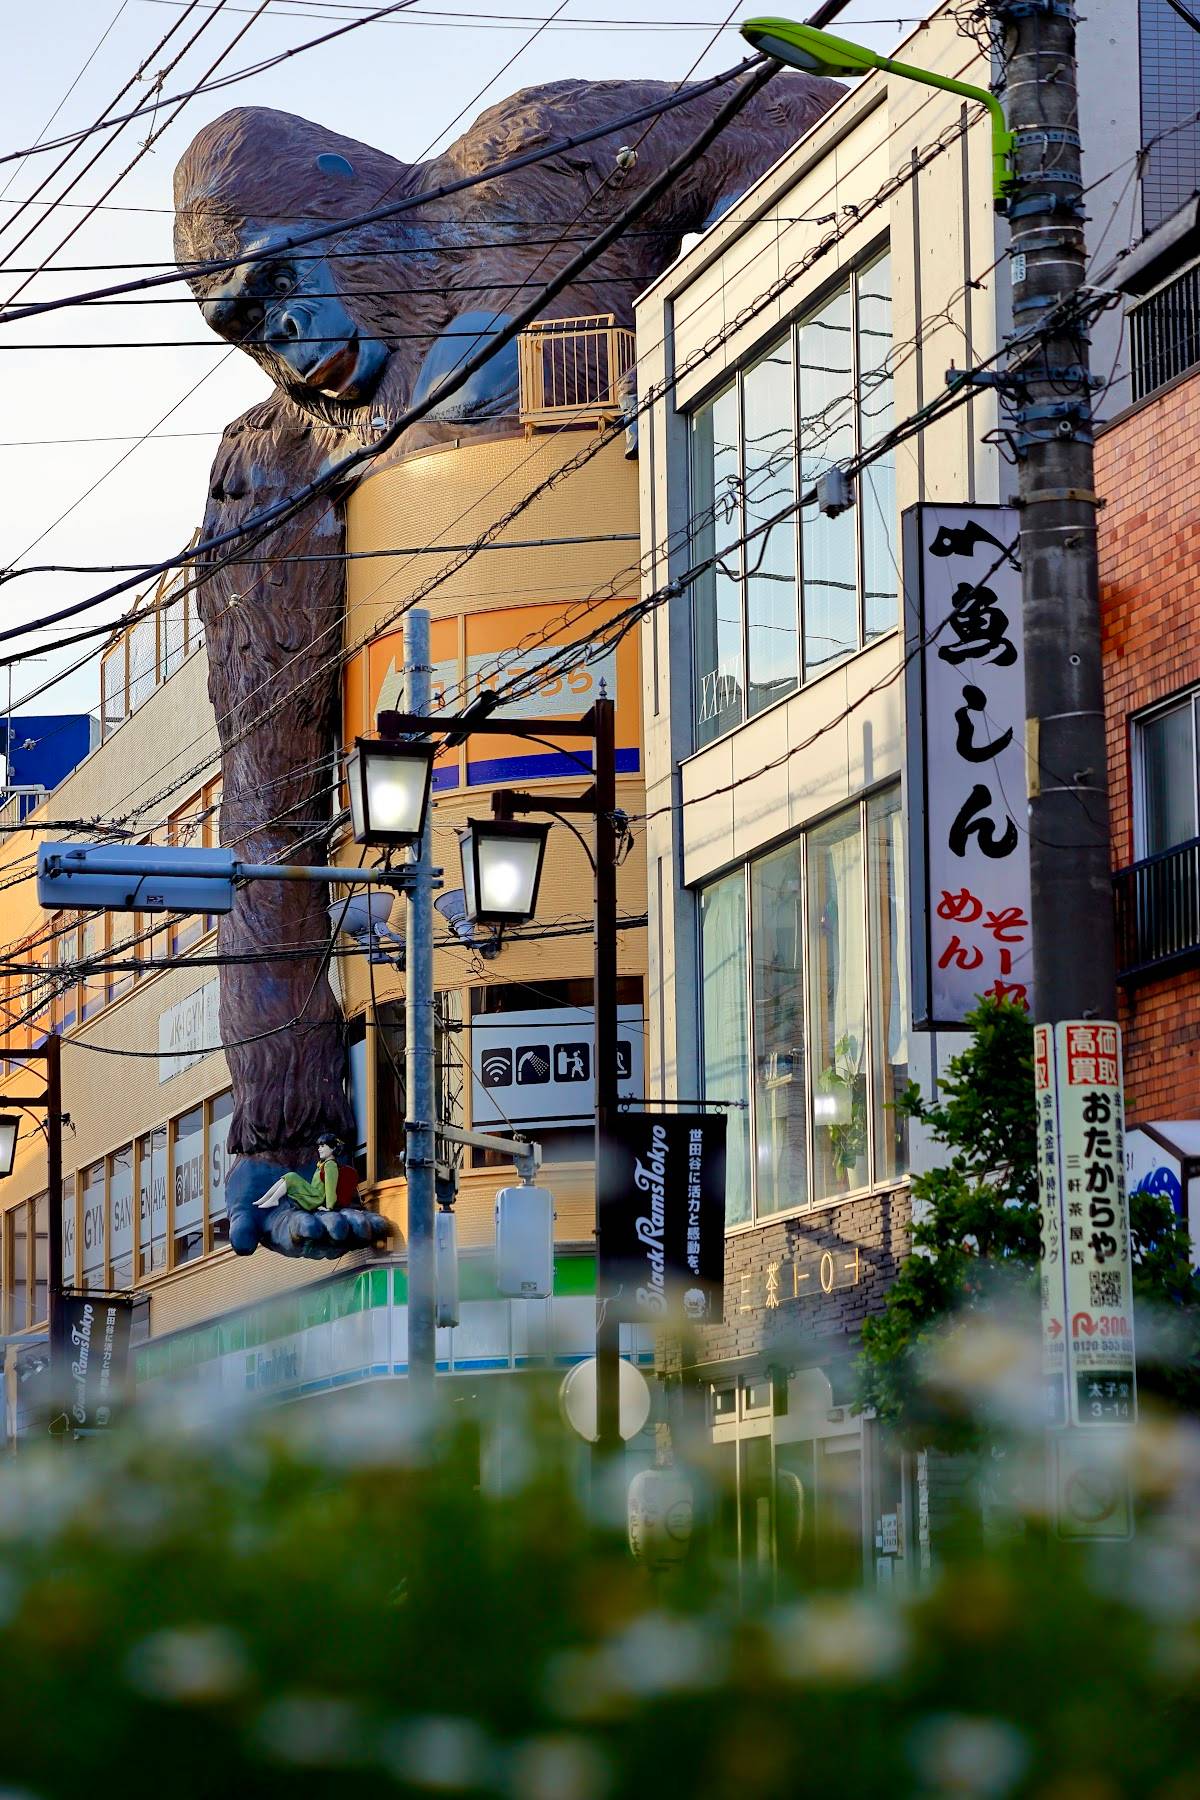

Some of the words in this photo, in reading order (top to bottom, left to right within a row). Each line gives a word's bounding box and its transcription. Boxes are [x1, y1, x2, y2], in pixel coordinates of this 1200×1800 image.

[634, 1124, 669, 1191] Tokyo
[1082, 1091, 1117, 1264] おたからや
[635, 1182, 665, 1250] Rams
[1067, 1154, 1085, 1265] 三軒茶屋店
[71, 1303, 95, 1346] Tokyo
[1091, 1402, 1128, 1417] 3-14
